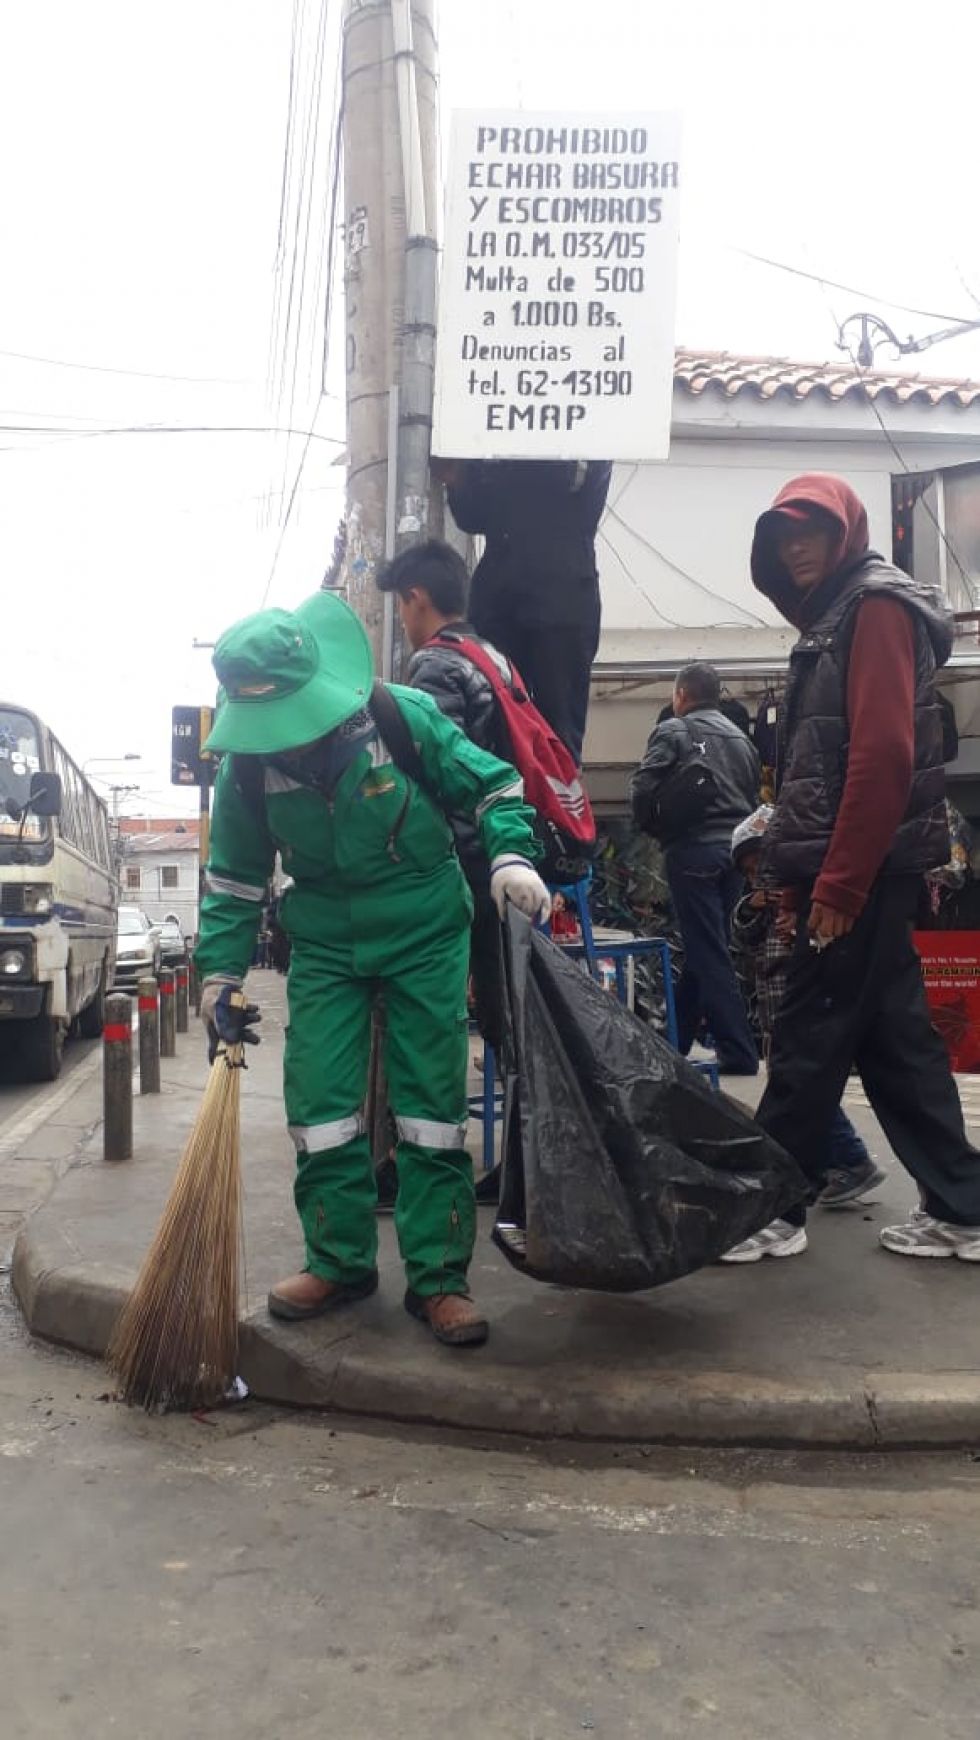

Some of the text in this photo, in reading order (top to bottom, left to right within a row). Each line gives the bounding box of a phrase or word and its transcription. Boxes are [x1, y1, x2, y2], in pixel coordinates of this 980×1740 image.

[477, 127, 648, 155] PROHIBIDO
[467, 162, 679, 190] ECHAR BASURA
[469, 196, 663, 224] Y ESCOMBROS
[466, 231, 497, 258] LA
[562, 231, 646, 260] 033/05
[464, 265, 645, 293] Multa de 500
[482, 300, 623, 328] a 1.000 Bs.
[462, 335, 625, 362] Denuncias al
[467, 369, 506, 397] tel.
[486, 404, 587, 432] EMAP
